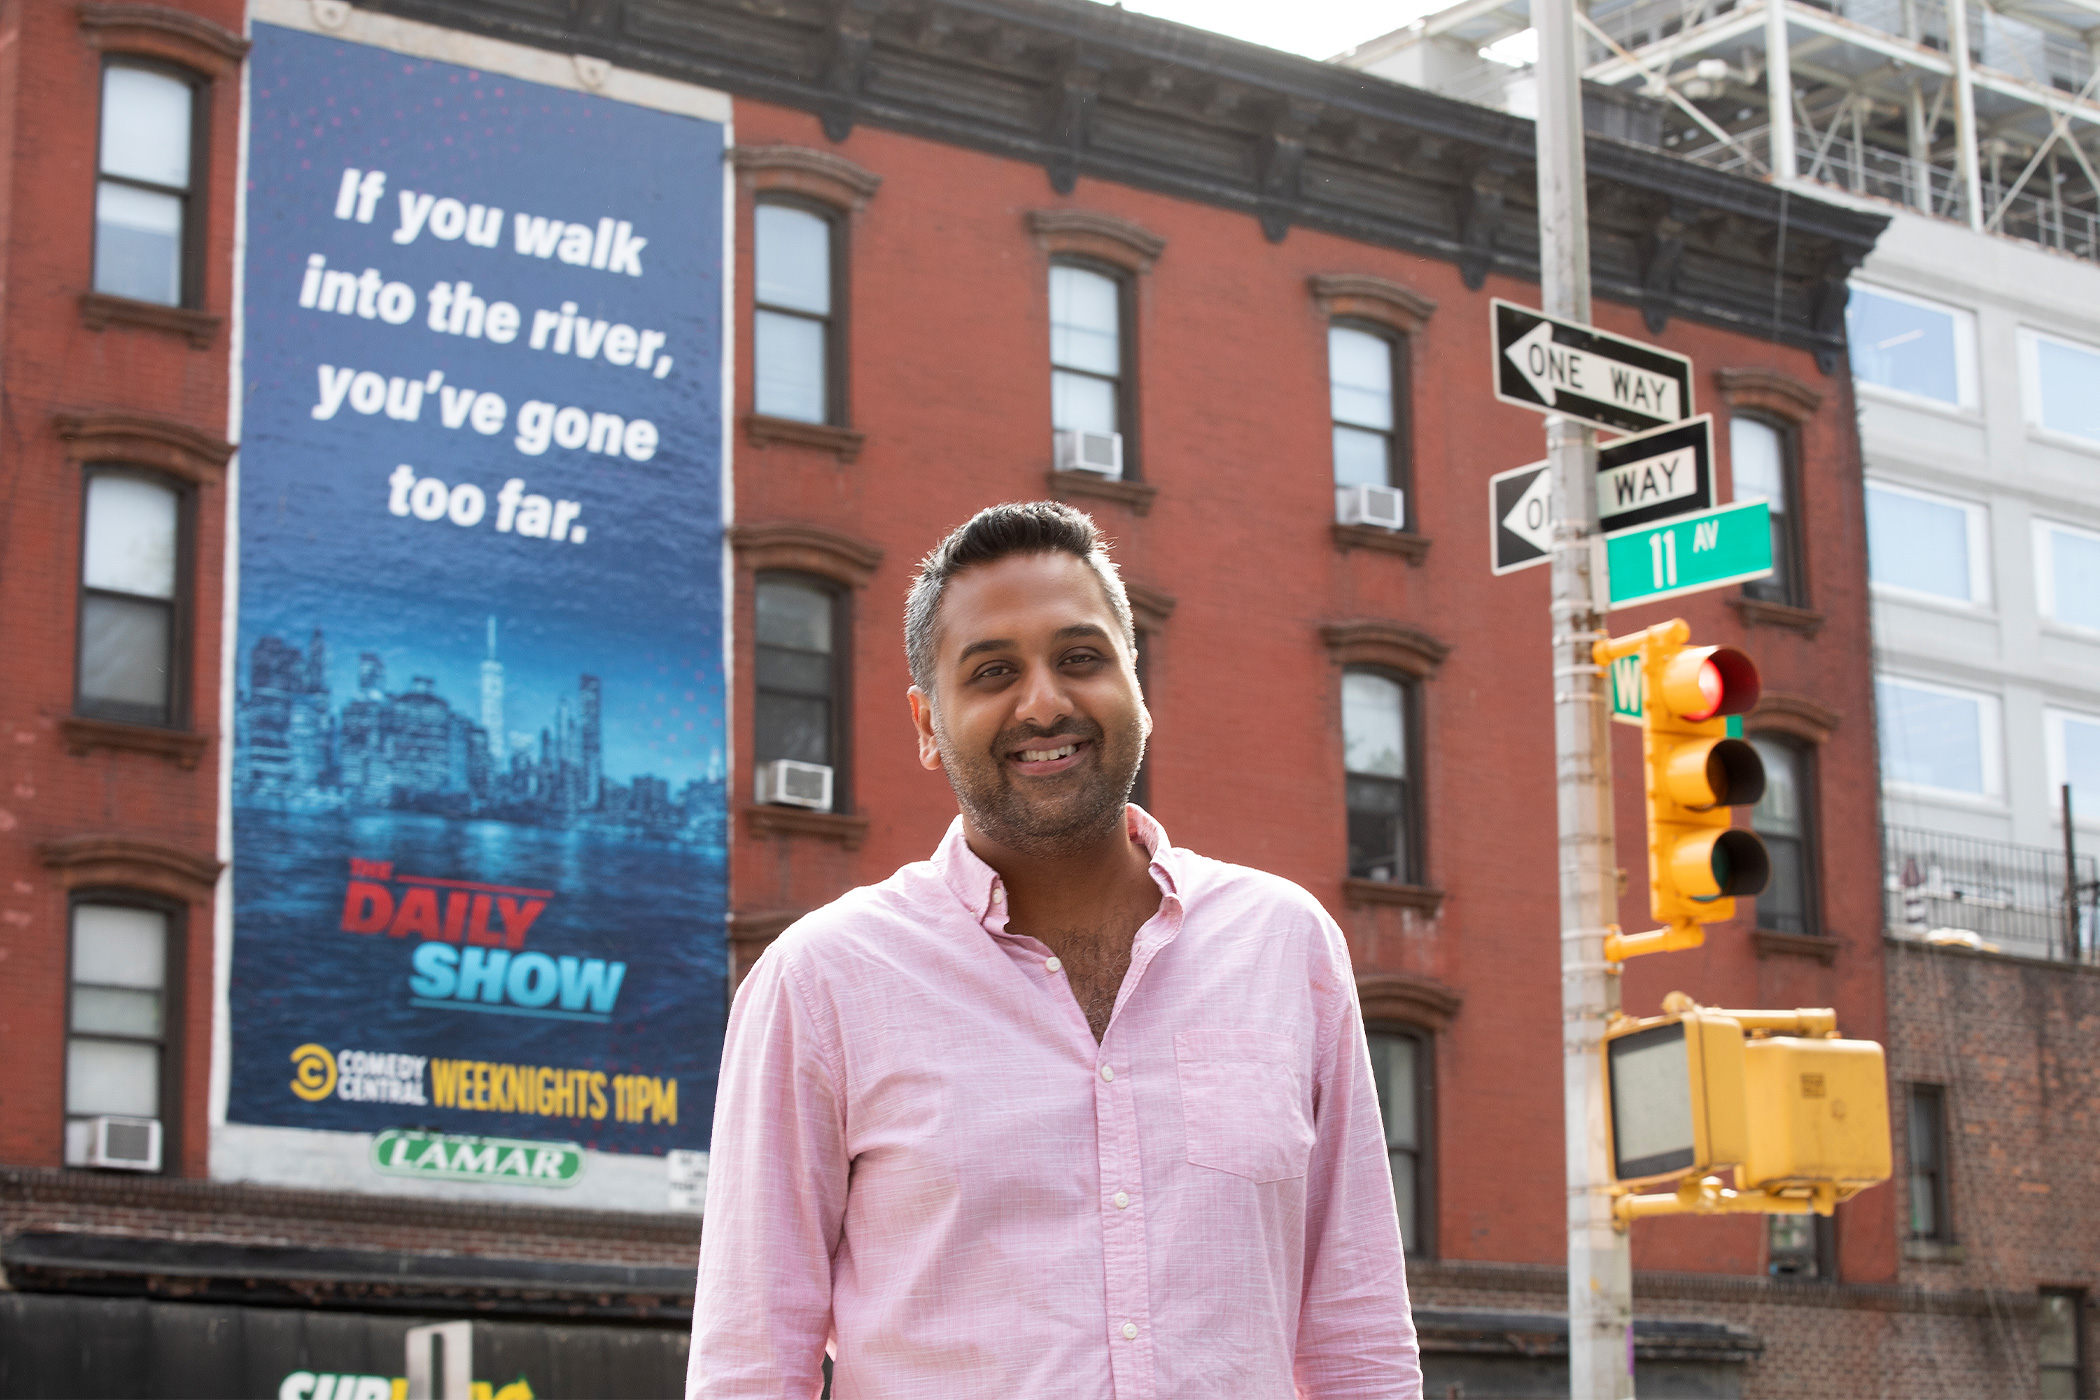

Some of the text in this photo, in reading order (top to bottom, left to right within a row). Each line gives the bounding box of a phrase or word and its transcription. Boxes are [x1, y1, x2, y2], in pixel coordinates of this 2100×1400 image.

[335, 168, 648, 277] If you walk
[300, 254, 674, 379] into the river,
[1527, 343, 1668, 413] ONE WAY
[311, 364, 659, 462] you've gone
[388, 464, 589, 544] too far.
[1614, 457, 1679, 507] WAY
[1649, 519, 1720, 589] 11 AV
[1613, 658, 1642, 713] W
[349, 857, 394, 882] THE
[340, 880, 548, 949] DAILY
[408, 941, 627, 1014] SHOW
[337, 1049, 428, 1080] COMEDY
[337, 1075, 429, 1106] CENTRAL
[430, 1057, 678, 1126] WEEKNIGHTS 11PM
[389, 1138, 565, 1178] LAMAR
